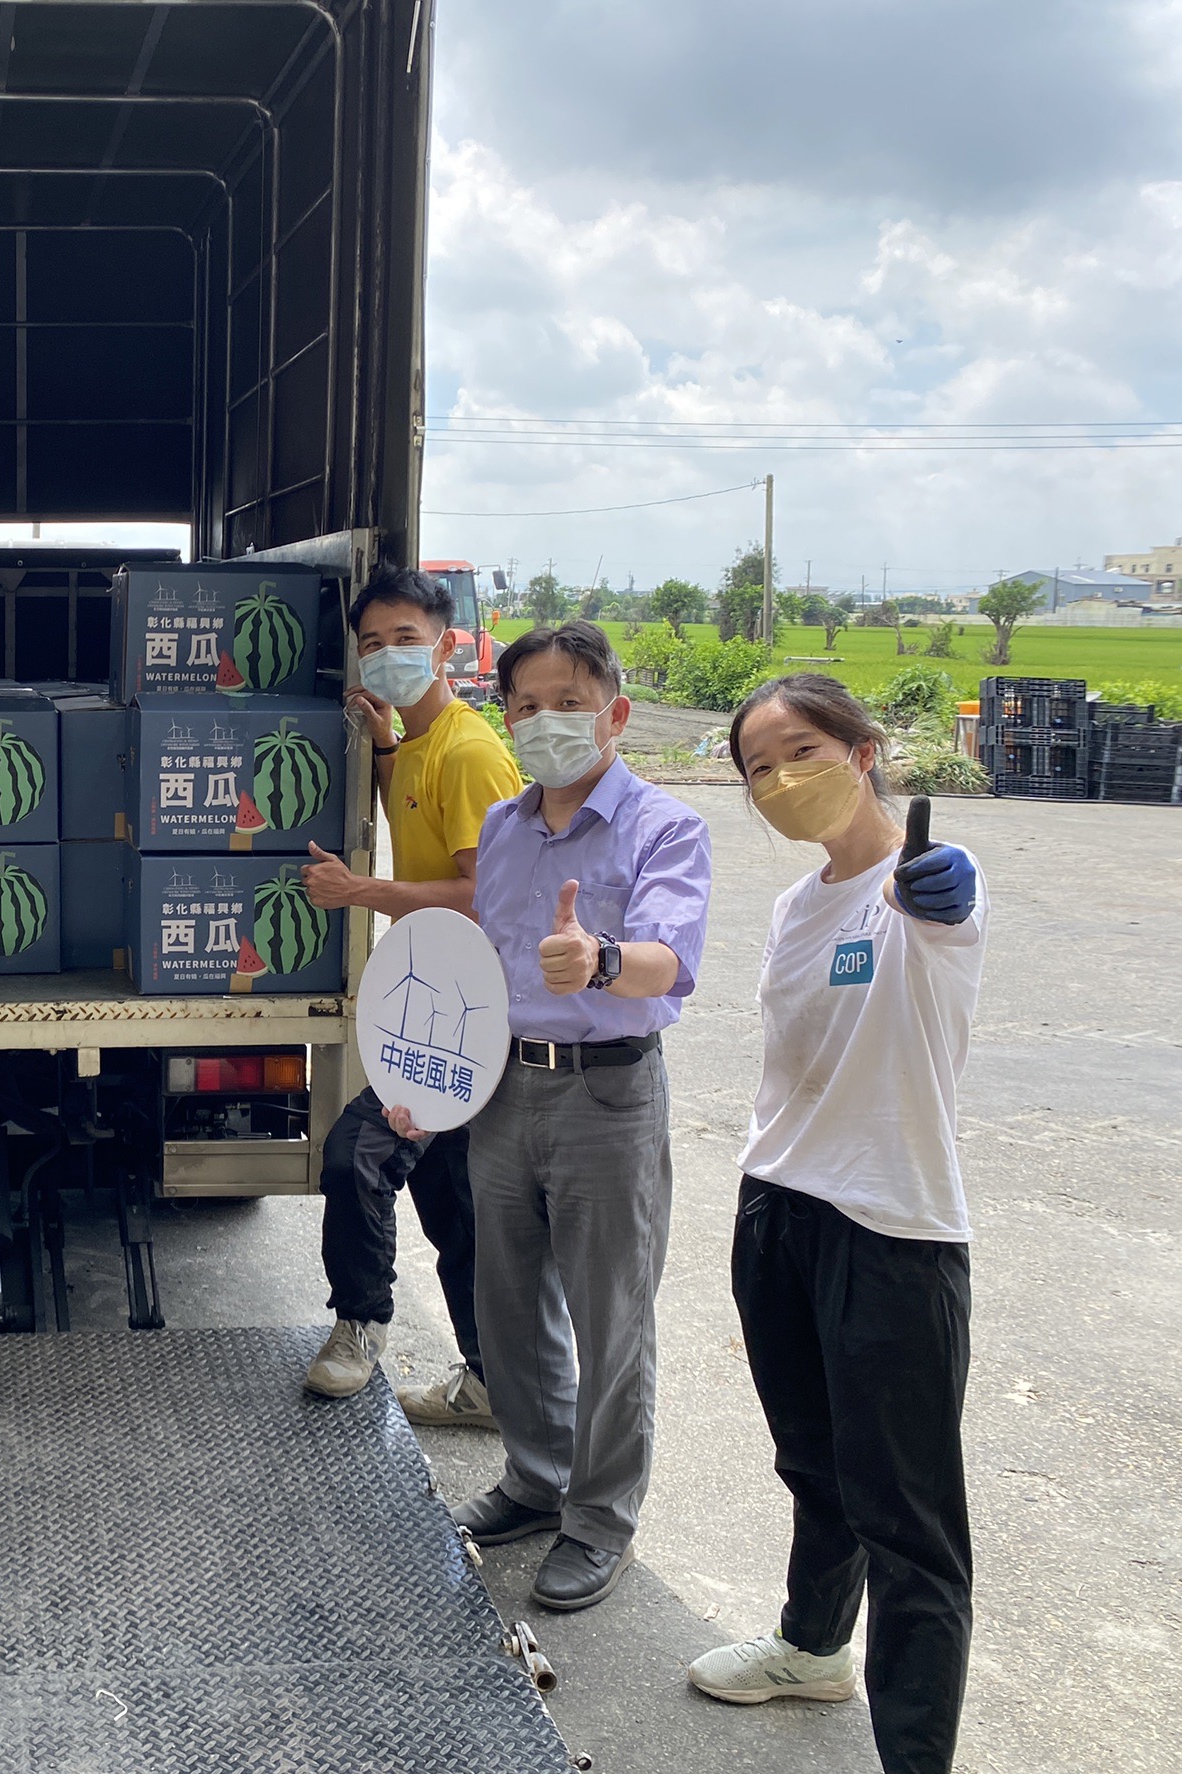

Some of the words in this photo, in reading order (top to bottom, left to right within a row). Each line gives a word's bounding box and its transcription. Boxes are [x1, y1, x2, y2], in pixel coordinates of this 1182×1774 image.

[147, 616, 224, 629] 彰化縣福興鄉
[145, 632, 220, 667] 西瓜
[145, 672, 217, 682] WATERMELON
[161, 756, 243, 768] 彰化縣福興鄉
[159, 771, 240, 808] 西瓜
[160, 814, 236, 824] WATERMELON
[162, 902, 243, 915] 彰化縣福興鄉
[160, 917, 240, 954] 西瓜
[162, 960, 237, 969] WATERMELON
[835, 951, 867, 975] COP
[379, 1040, 474, 1103] 中能風場
